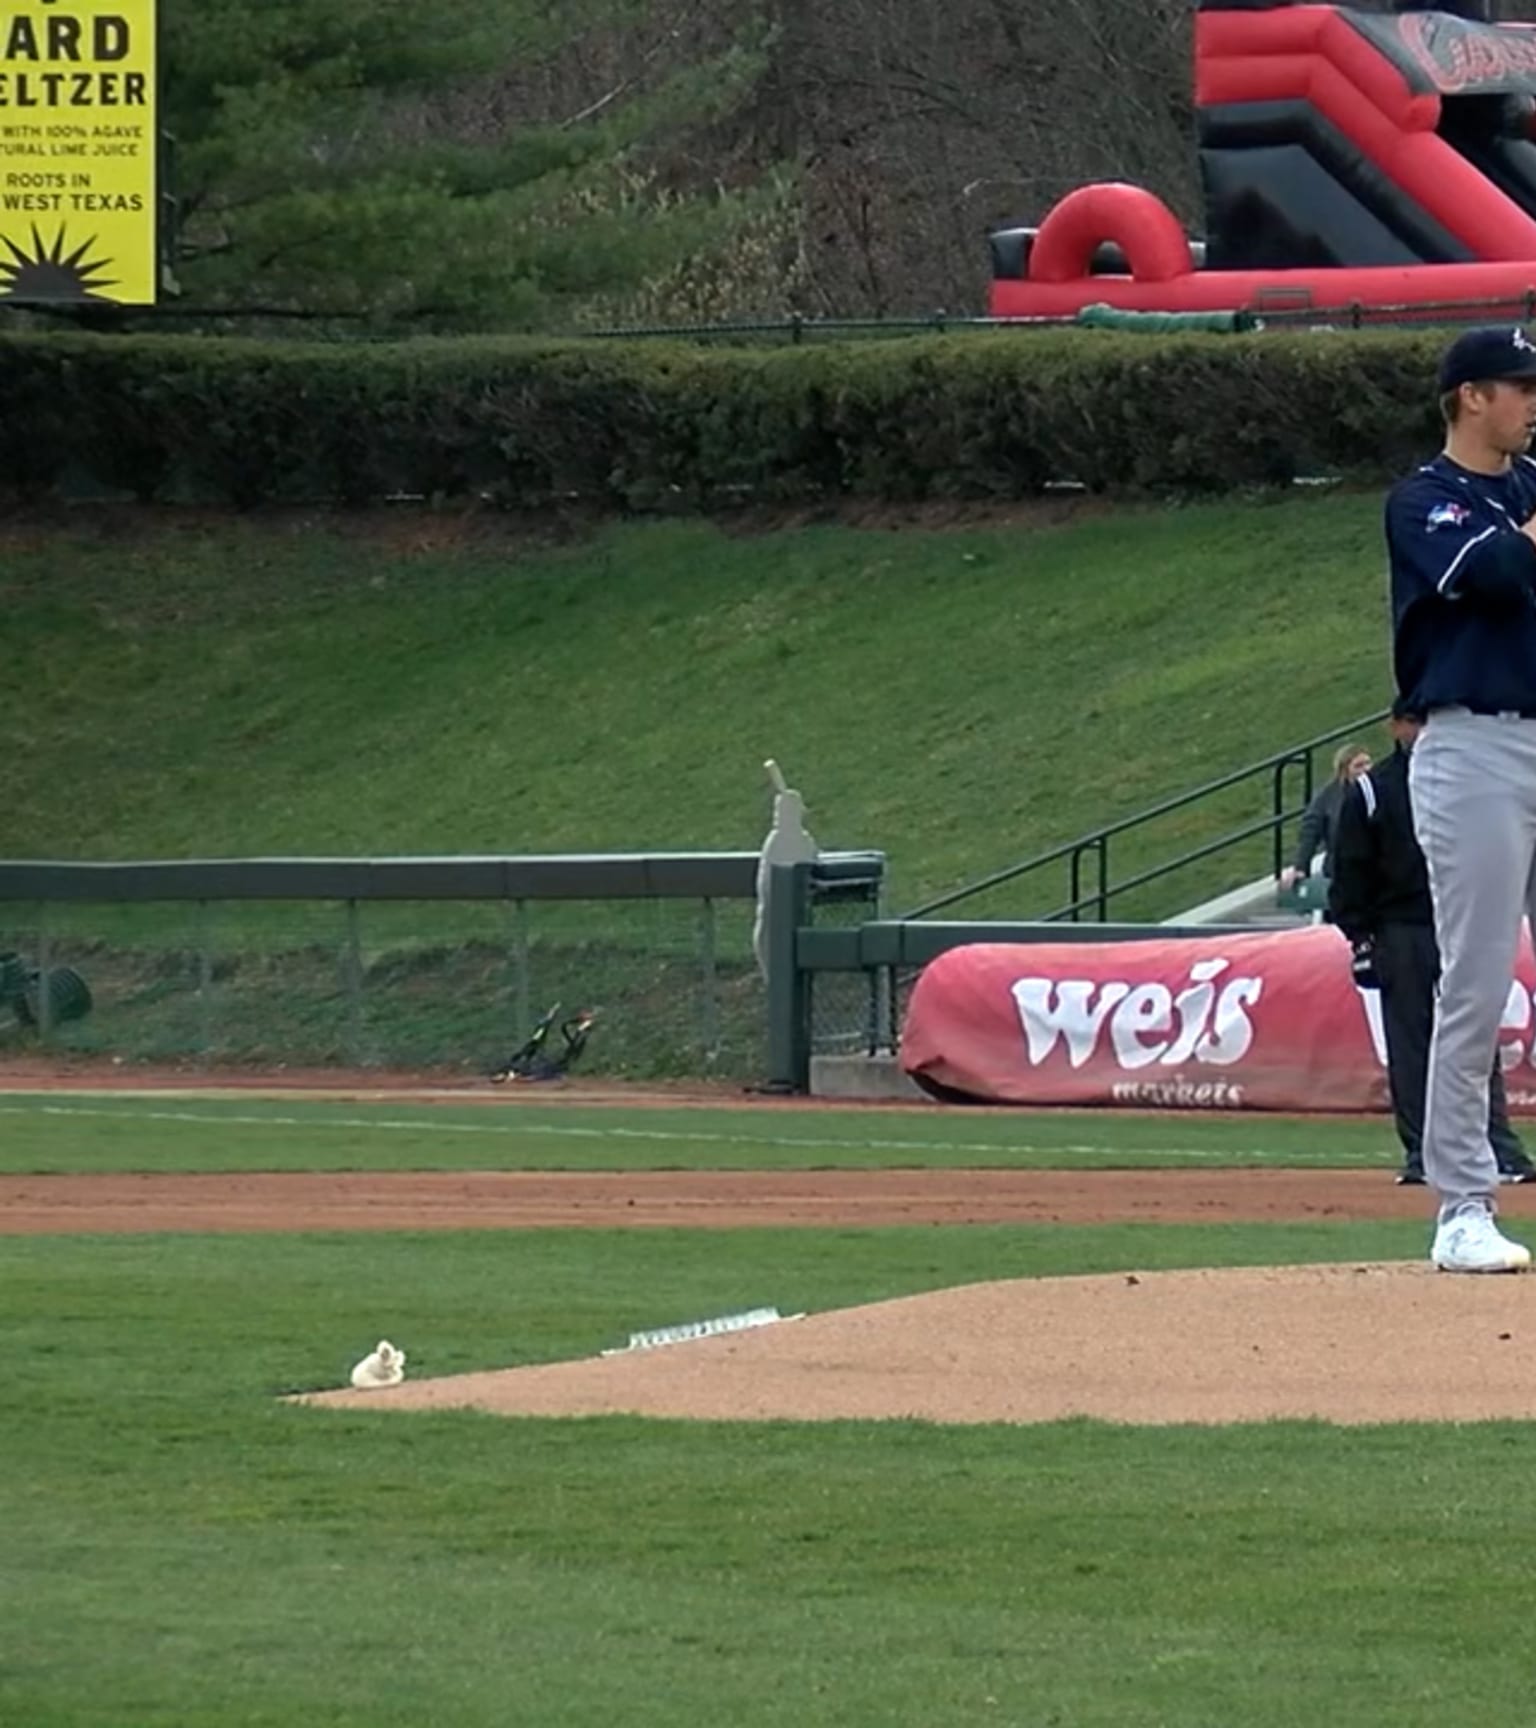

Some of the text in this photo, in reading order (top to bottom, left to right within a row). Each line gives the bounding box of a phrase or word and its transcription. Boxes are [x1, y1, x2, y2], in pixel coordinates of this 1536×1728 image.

[91, 125, 143, 138] AGAVE
[50, 143, 87, 156] LIME
[92, 143, 138, 156] JUICE
[5, 172, 91, 188] ROOTS IN
[2, 193, 143, 211] WEST TEXAS
[1011, 956, 1263, 1071] weis
